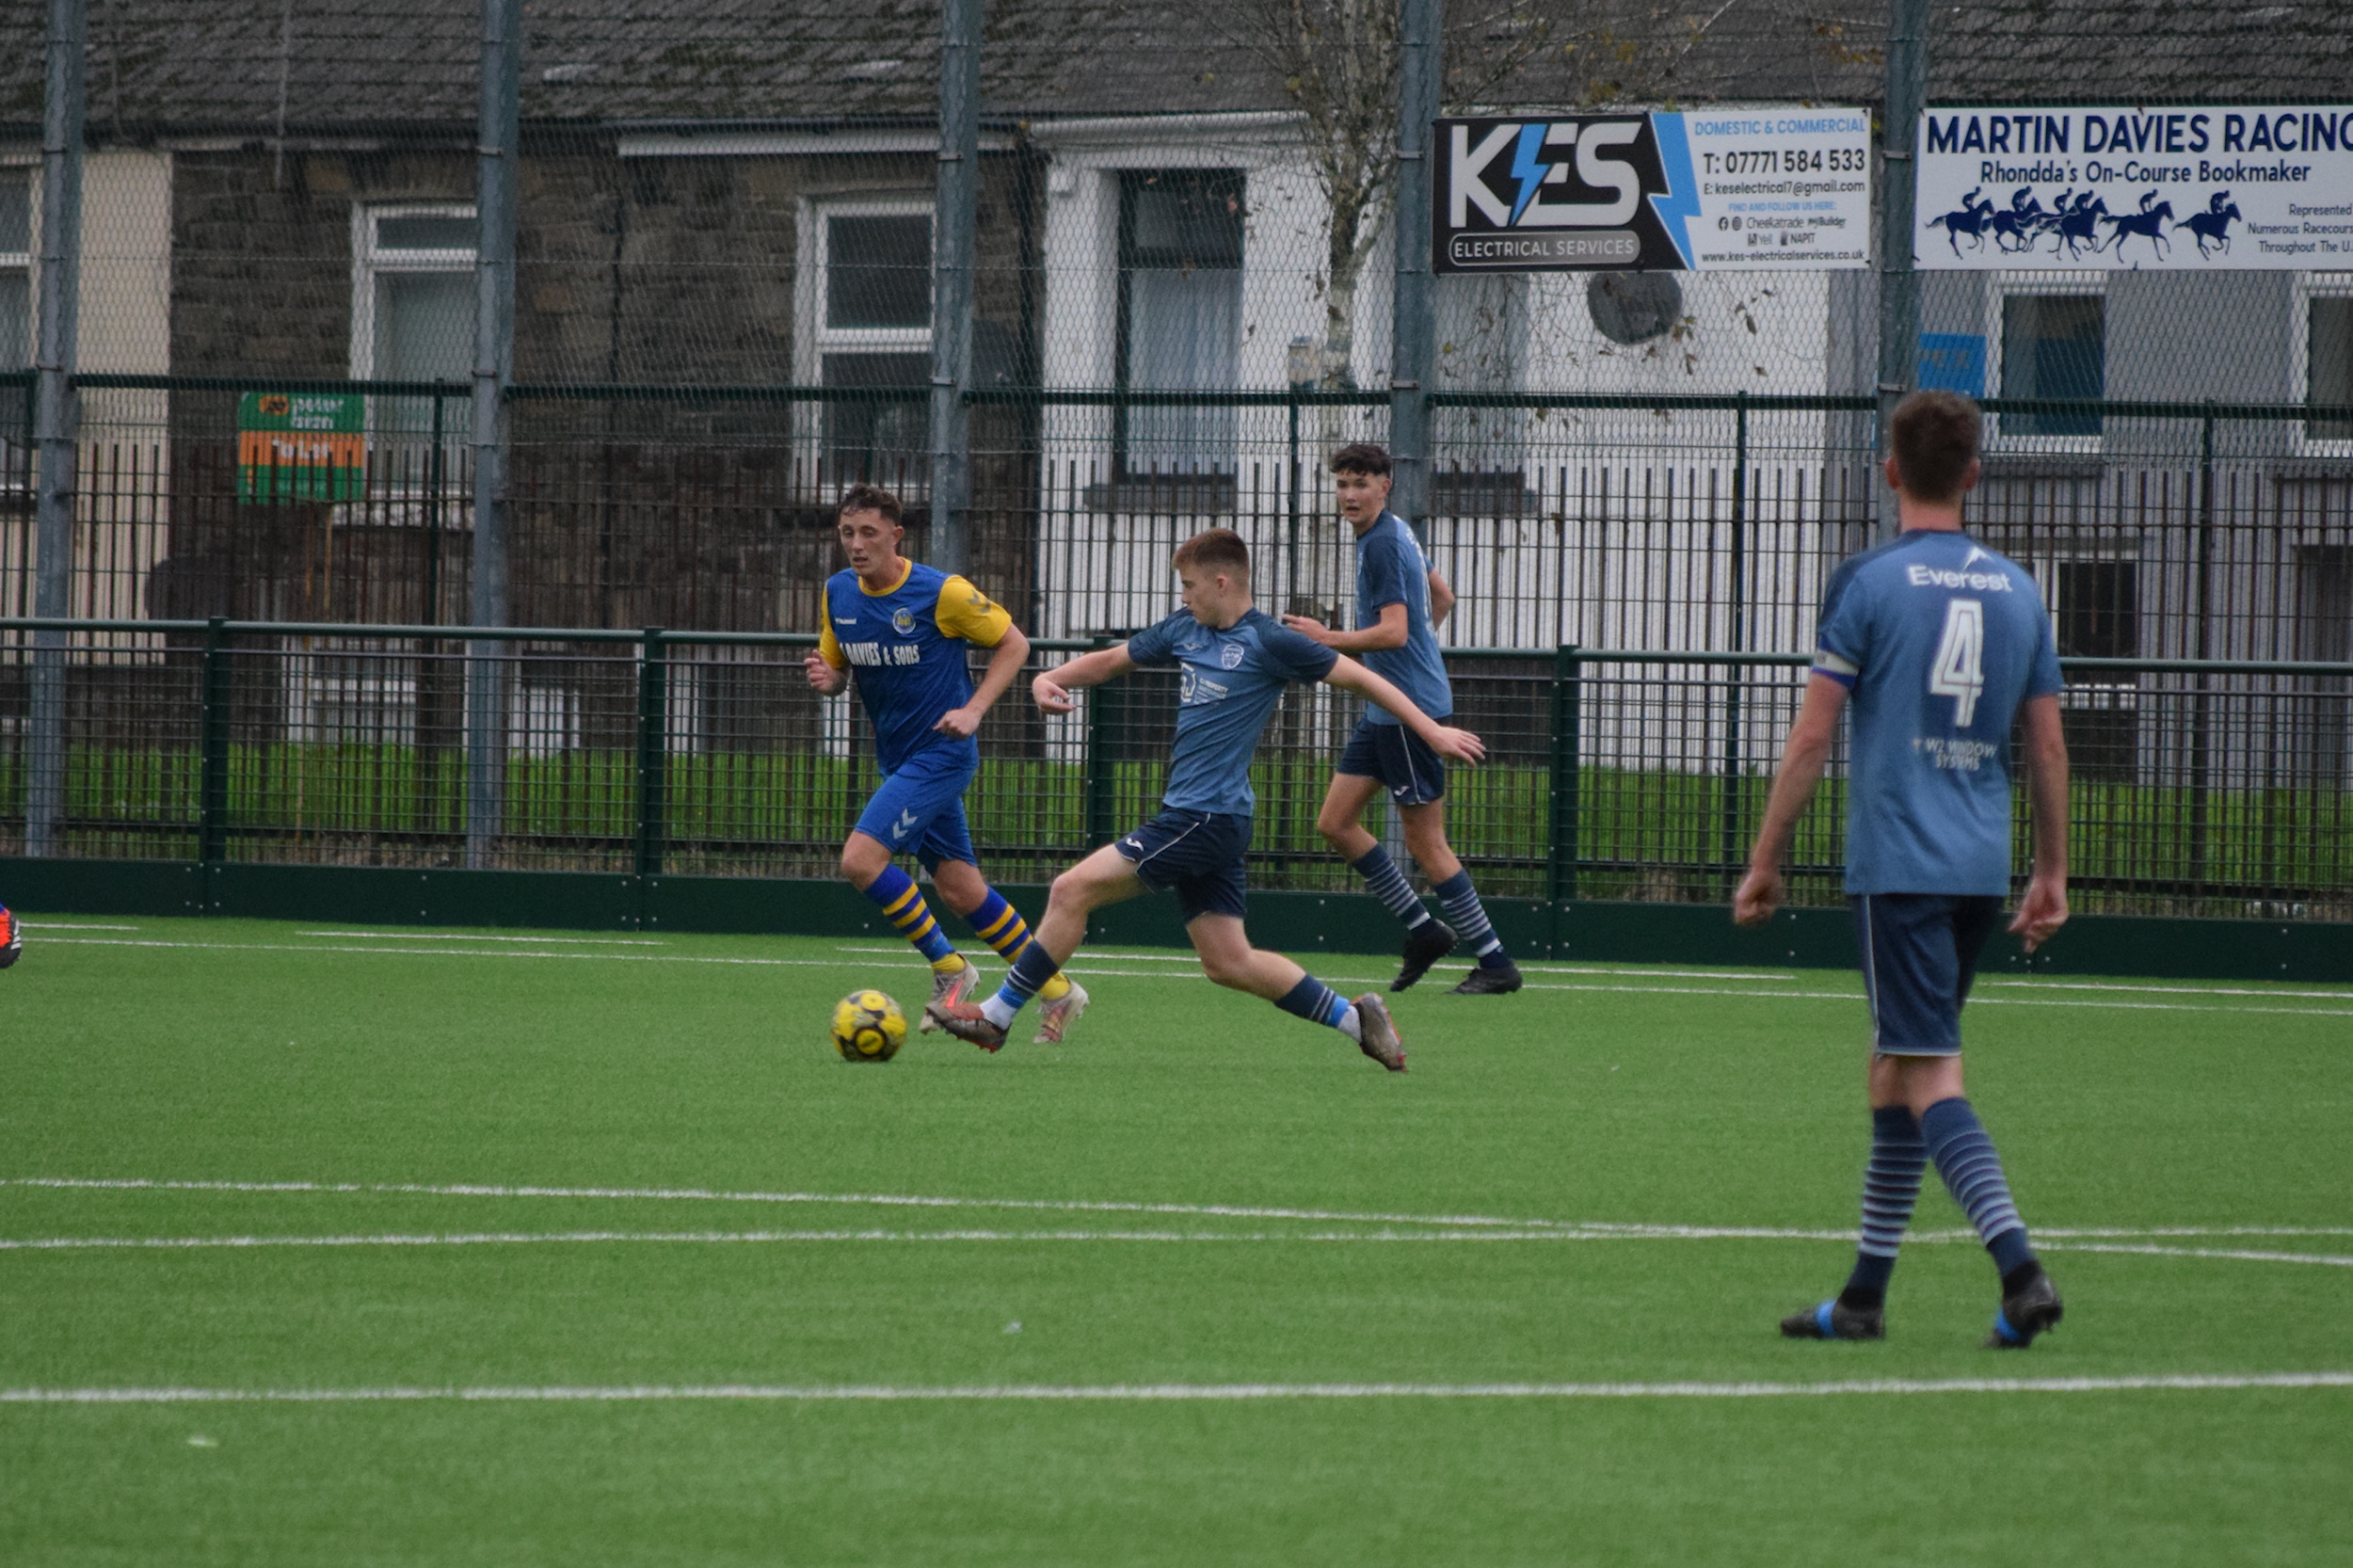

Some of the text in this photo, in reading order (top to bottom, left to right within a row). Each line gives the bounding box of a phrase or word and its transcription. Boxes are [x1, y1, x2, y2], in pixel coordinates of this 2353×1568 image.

[1694, 118, 1865, 136] DOMESTIC & COMMERCIAL
[1928, 115, 2070, 153] MARTIN
[2084, 114, 2210, 153] DAVIES
[1704, 149, 1865, 174] T: 07771 584 533
[1981, 159, 2312, 183] Rhondda's On-Course Bookmaker
[1449, 121, 1642, 228] KES
[1704, 180, 1865, 197] E: keselectrical7@gmail.com
[1728, 202, 1748, 212] FIND
[1749, 202, 1767, 211] AND
[1768, 201, 1801, 211] FOLLOW
[1802, 201, 1813, 211] US
[2289, 202, 2353, 218] Represented
[2248, 222, 2299, 234] Numerous
[1454, 239, 1635, 258] ELECTRICAL SERVICES
[1702, 249, 1865, 263] www.kes-electricalservices.co.uk
[2259, 240, 2316, 255] Throughout
[2320, 240, 2338, 252] The
[1908, 564, 2013, 592] Everest
[1930, 598, 1985, 728] 4
[1947, 740, 1998, 759] WINDOW
